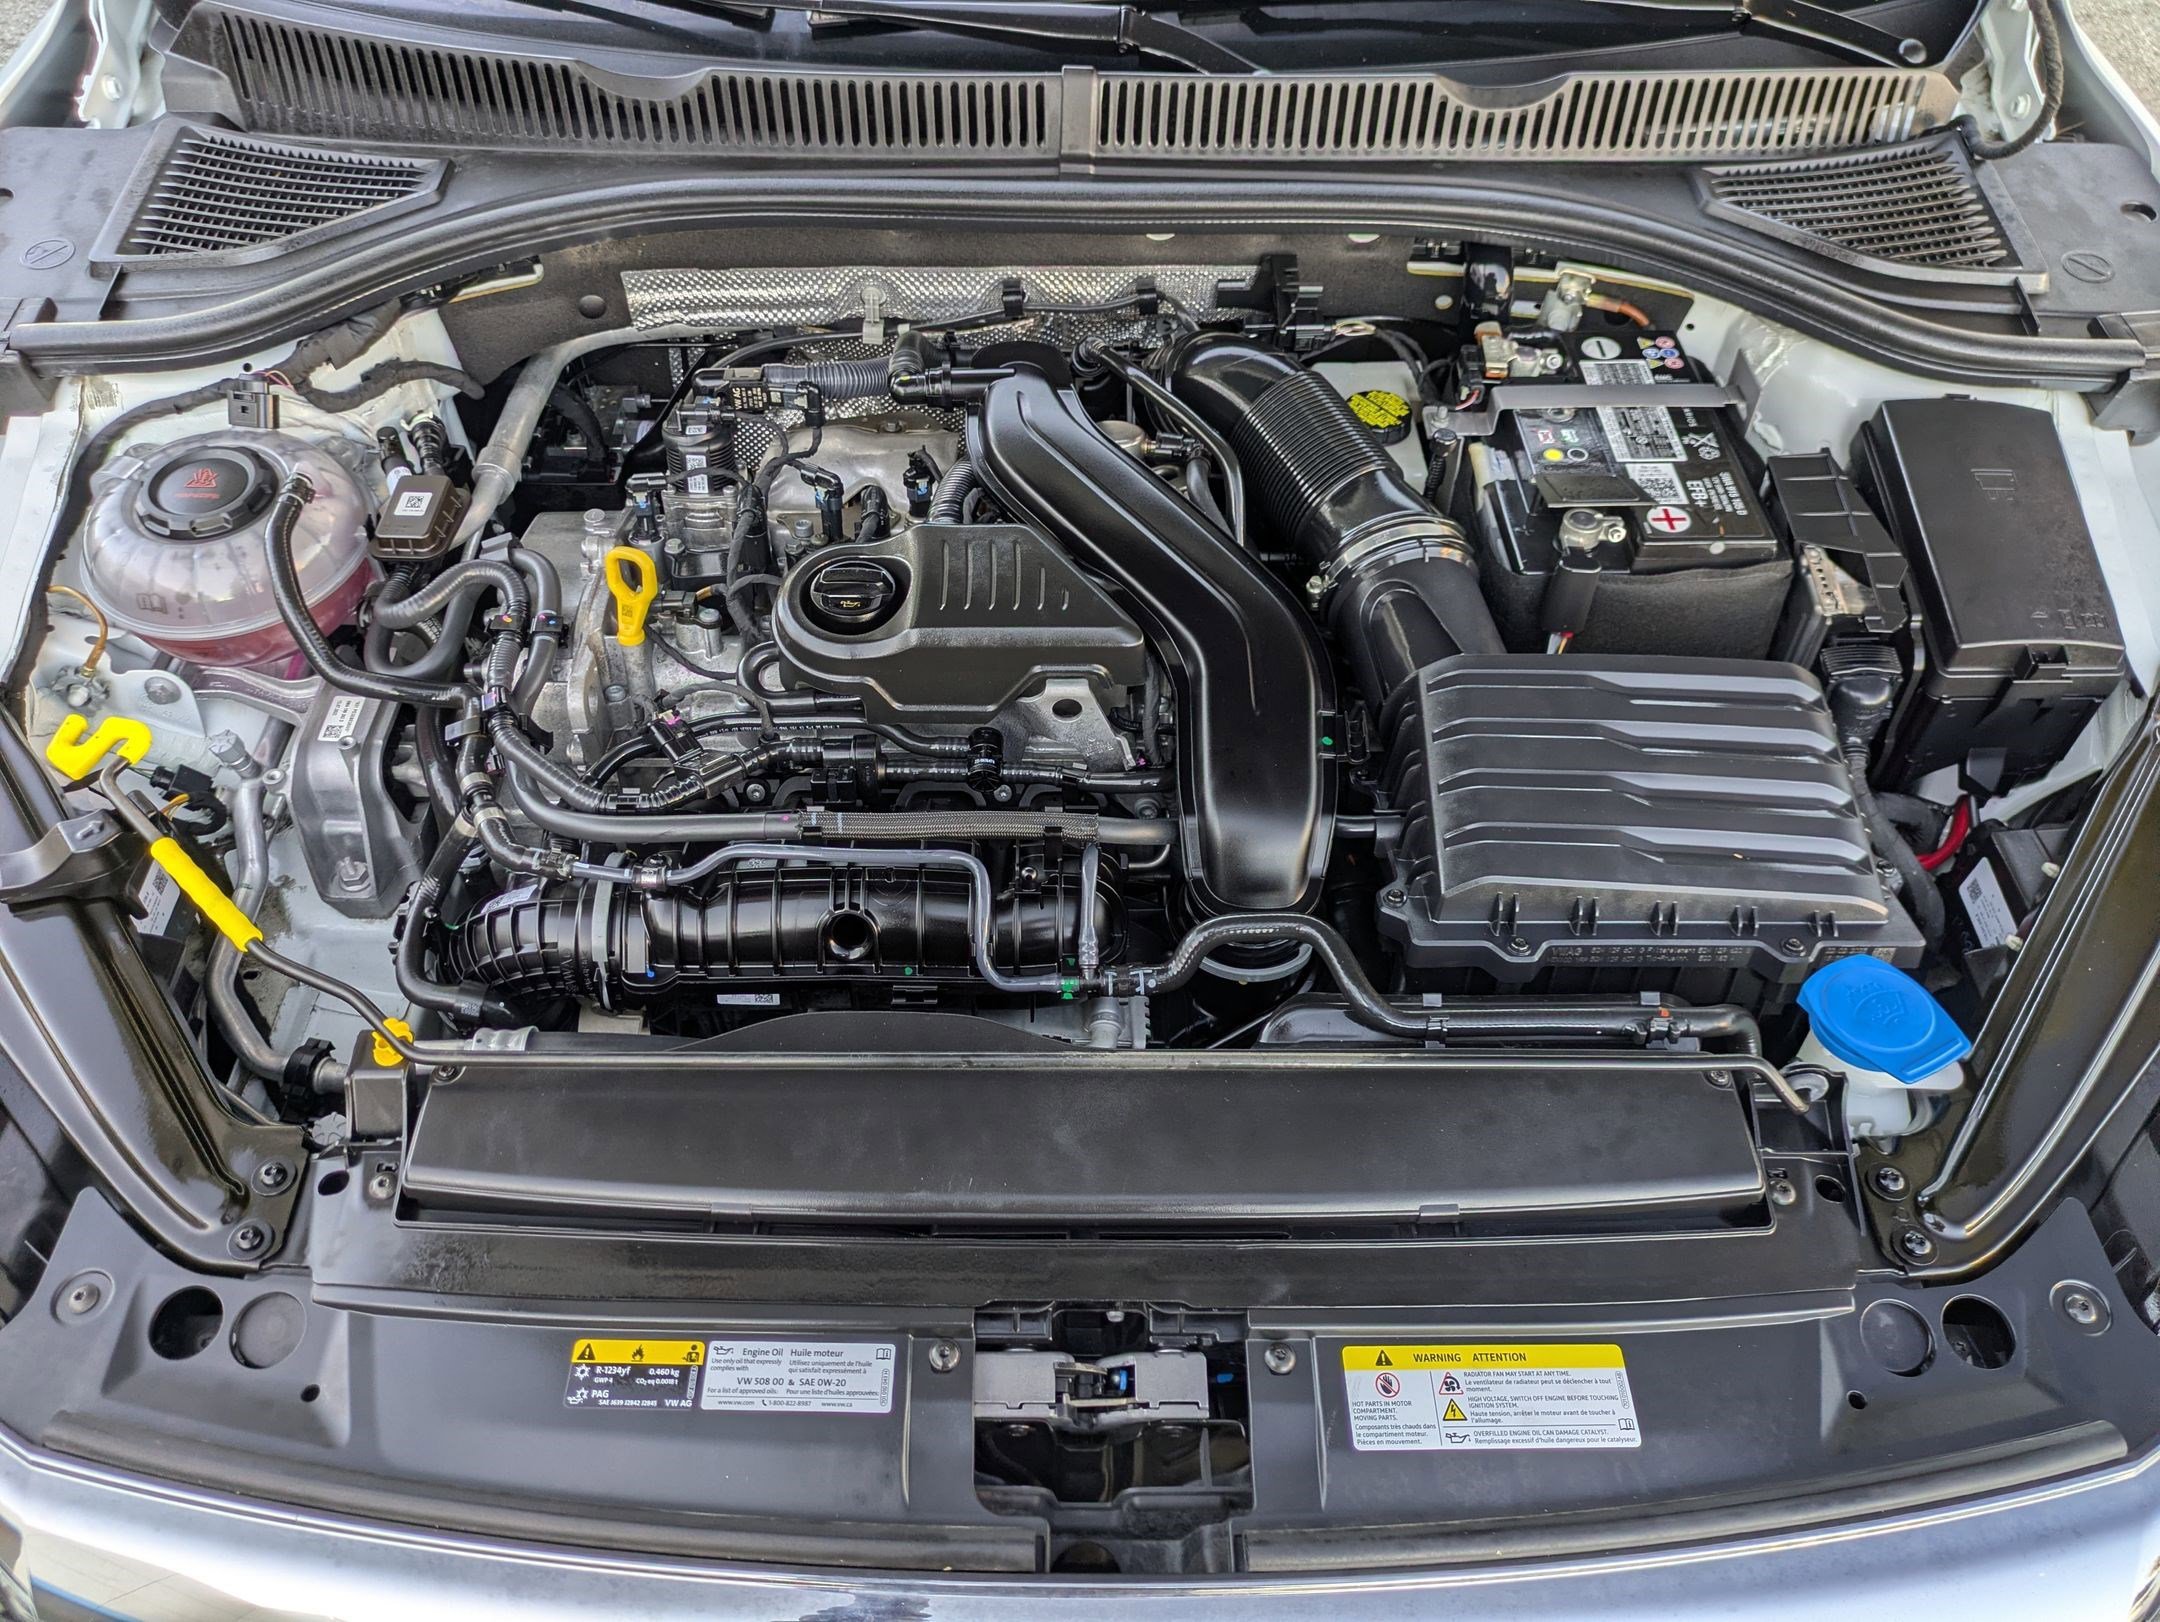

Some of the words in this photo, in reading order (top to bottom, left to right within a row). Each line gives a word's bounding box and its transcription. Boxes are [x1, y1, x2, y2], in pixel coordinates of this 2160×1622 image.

[1685, 480, 1708, 508] EFB+
[743, 1348, 770, 1358] Engine
[772, 1348, 783, 1356] Oil
[1413, 1353, 1461, 1362] WARNING
[1473, 1353, 1526, 1362] ATTENTION
[596, 1366, 631, 1376] R-1234yf
[671, 1368, 680, 1378] kg
[591, 1390, 609, 1398] PAG
